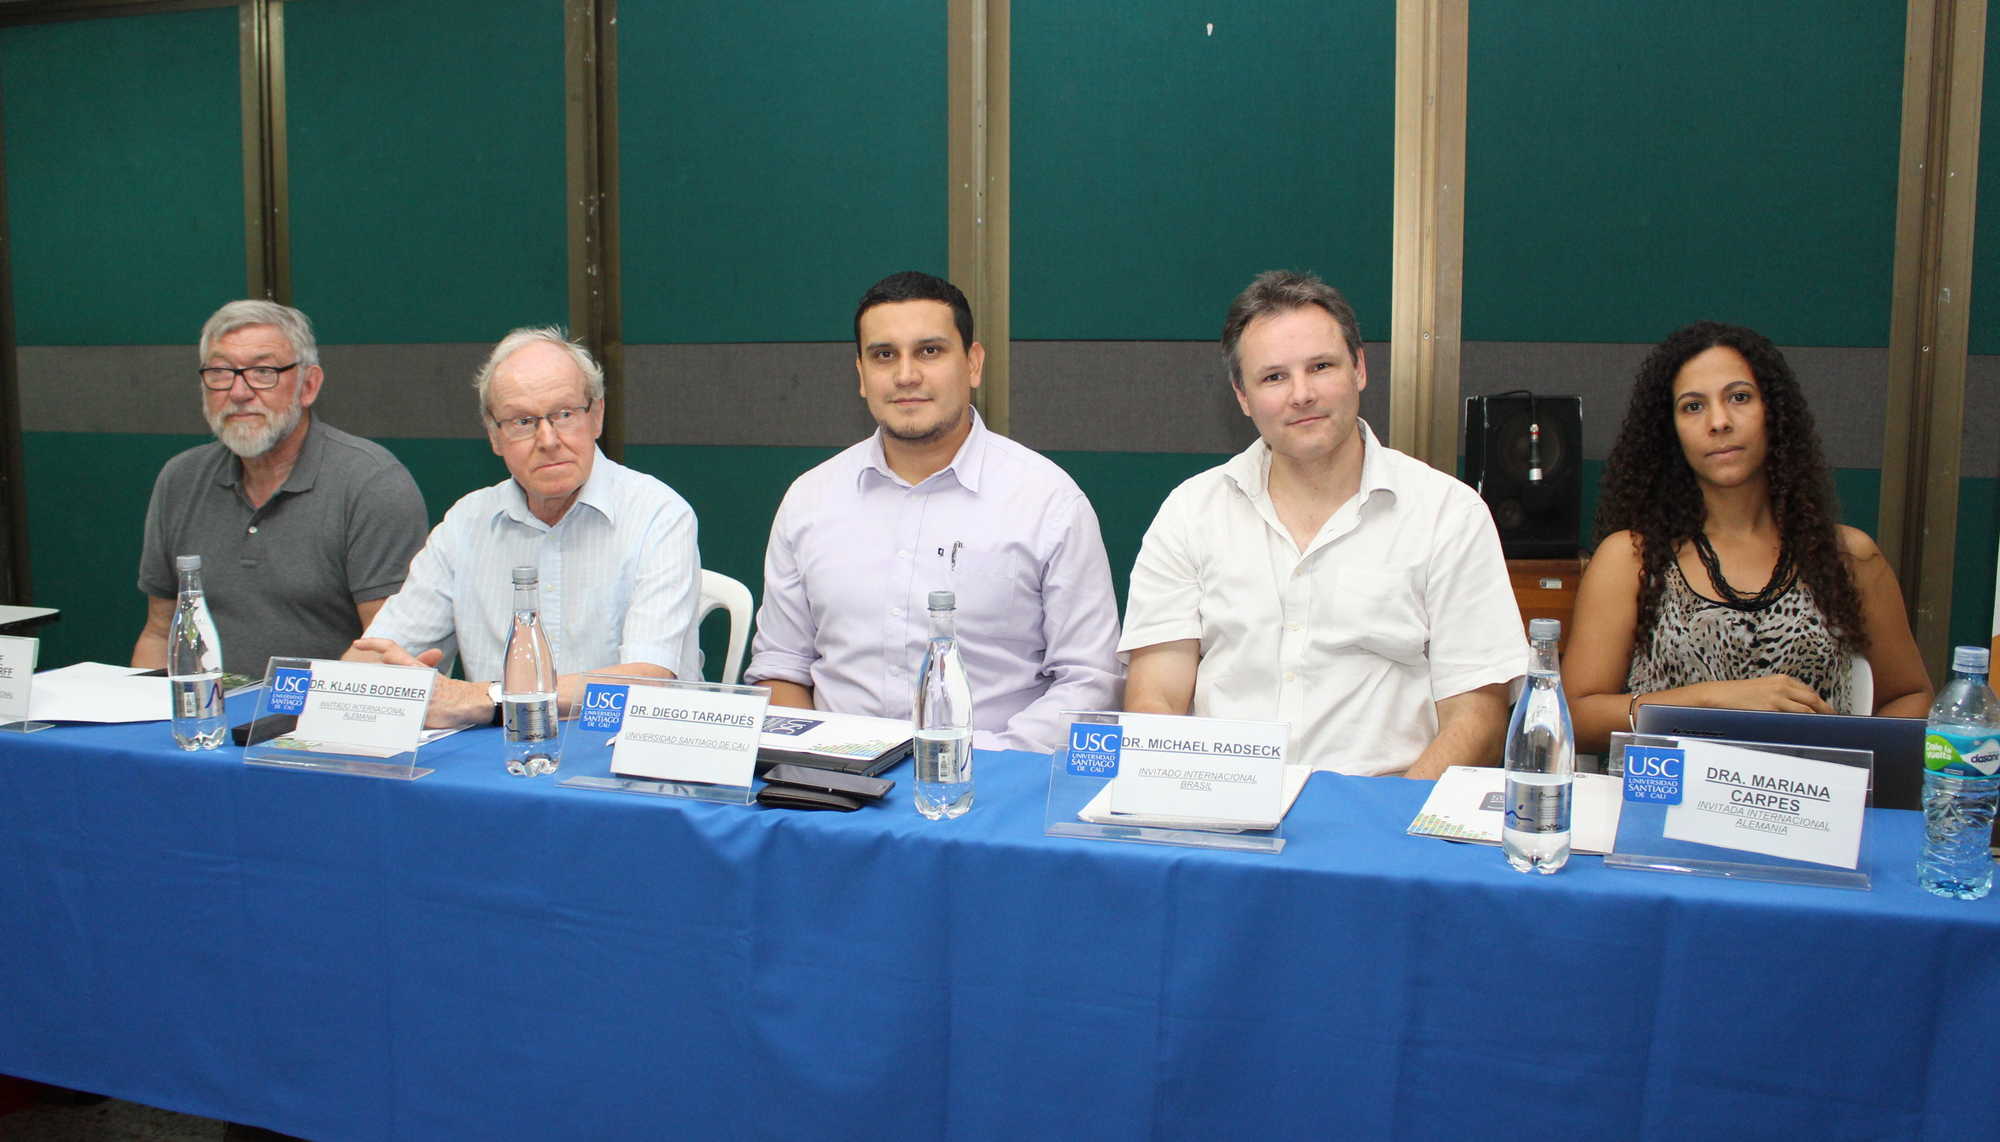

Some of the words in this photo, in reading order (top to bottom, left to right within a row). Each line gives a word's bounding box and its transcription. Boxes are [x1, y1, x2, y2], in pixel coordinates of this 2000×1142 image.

[274, 675, 309, 693] USC
[310, 680, 327, 690] DR.
[330, 681, 367, 694] KLAUS
[370, 685, 426, 698] BODEMER
[271, 698, 303, 706] SANTIAGO
[586, 691, 625, 710] USC
[352, 705, 406, 716] INTERNACIONAL
[630, 705, 649, 716] DR.
[652, 707, 689, 720] DIEGO
[583, 715, 620, 724] SANTIAGO
[625, 731, 678, 744] UNIVERSIDAD
[678, 736, 718, 748] SANTIAGO
[719, 741, 730, 750] DE
[1072, 732, 1118, 753] USC
[1121, 737, 1144, 748] DR.
[1147, 738, 1209, 752] MICHAEL
[1213, 742, 1281, 757] RADSECK
[1071, 753, 1116, 761] UNIVERSIDAD
[1071, 758, 1115, 768] SANTIAGO
[1137, 767, 1182, 779] INVITADO
[1183, 769, 1257, 783] INTERNACIONAL
[1628, 757, 1680, 778] USC
[1180, 780, 1213, 791] BRASIL
[1628, 778, 1678, 786] UNIVERSIDAD
[1628, 783, 1678, 794] SANTIAGO
[1706, 767, 1745, 785] DRA.
[1752, 774, 1831, 799] MARIANA
[1650, 792, 1666, 800] CALI
[1730, 789, 1800, 812] CARPES
[1697, 800, 1745, 816] INVITADA
[1746, 806, 1831, 832] INTERNACIONAL
[1735, 818, 1788, 835] ALEMANIA
